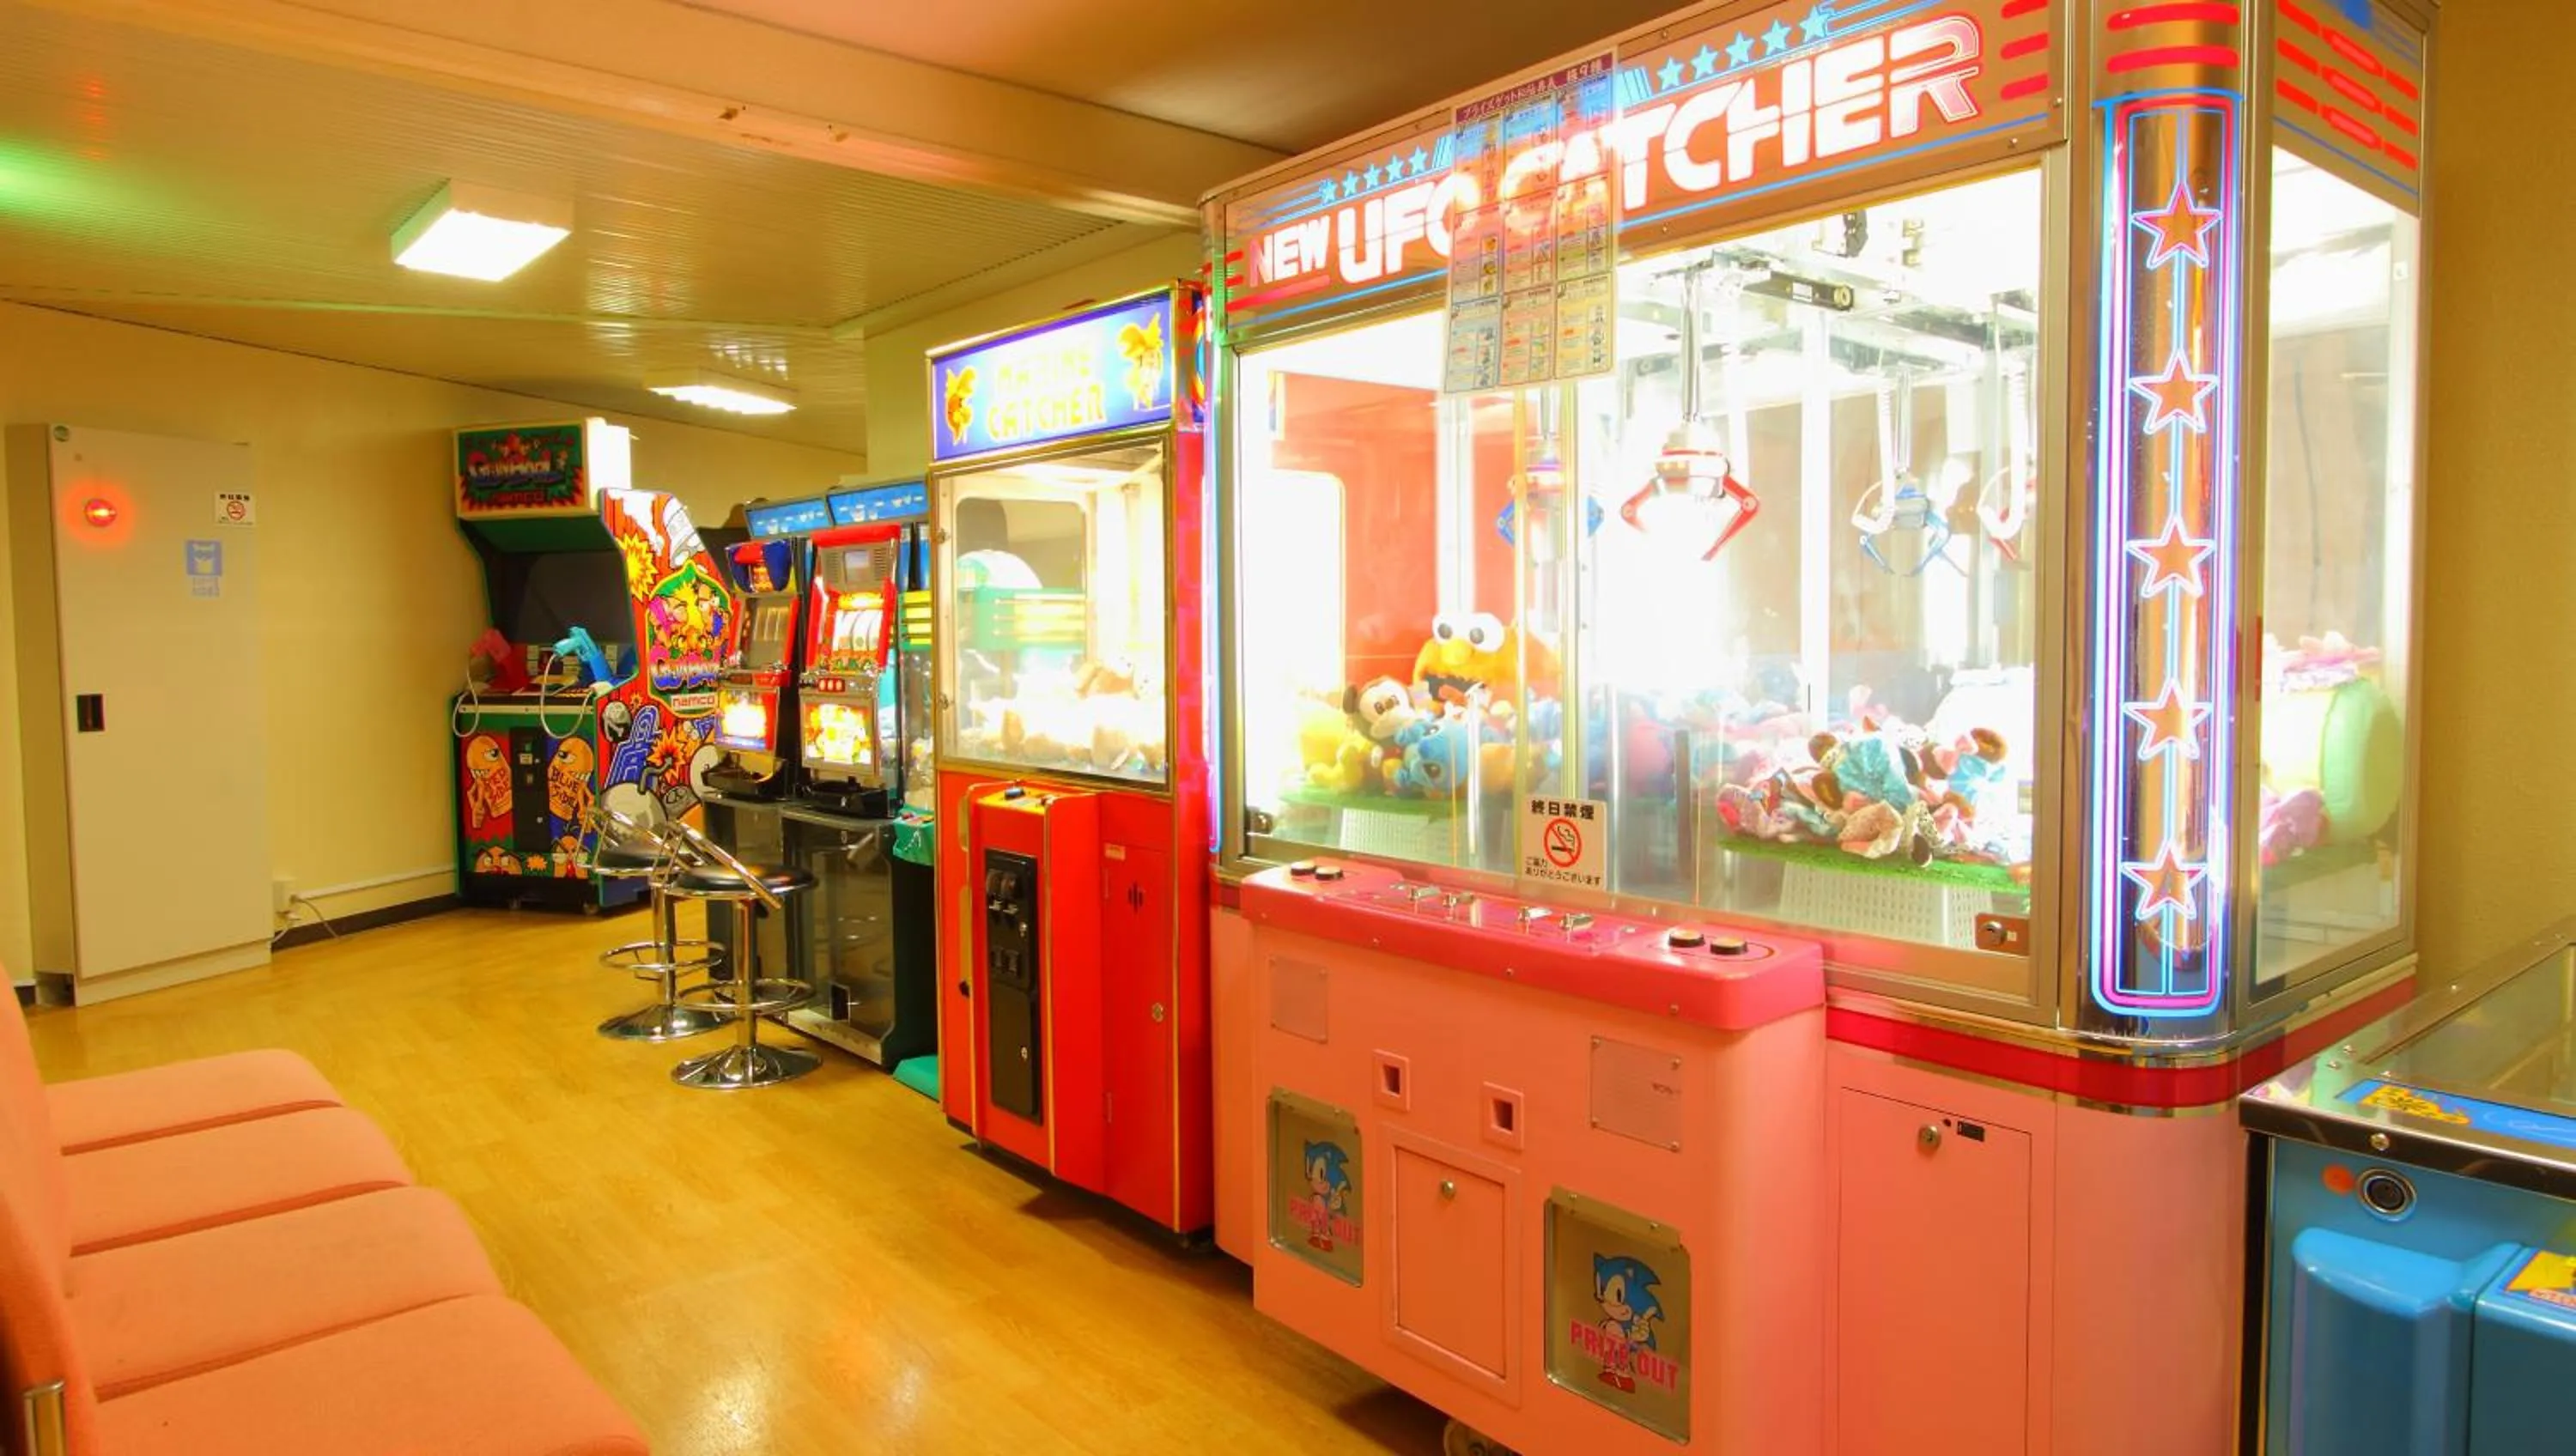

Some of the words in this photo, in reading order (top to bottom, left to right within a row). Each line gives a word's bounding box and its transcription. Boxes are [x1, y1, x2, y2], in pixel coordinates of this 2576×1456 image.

[1249, 215, 1329, 288] NEW
[1337, 172, 1481, 285] UFO
[1501, 15, 1980, 235] CATCHER
[987, 382, 1105, 439] CATCHER
[672, 695, 715, 707] namco
[552, 767, 578, 793] BLUE
[550, 783, 577, 808] SIDE
[1531, 799, 1595, 820] 終日禁煙
[1526, 856, 1547, 867] ご協力
[1525, 866, 1601, 885] ありがとうございます
[1290, 1197, 1327, 1235] PRIZE
[1571, 1319, 1629, 1368] PRIZE
[1637, 1350, 1678, 1389] OUT
